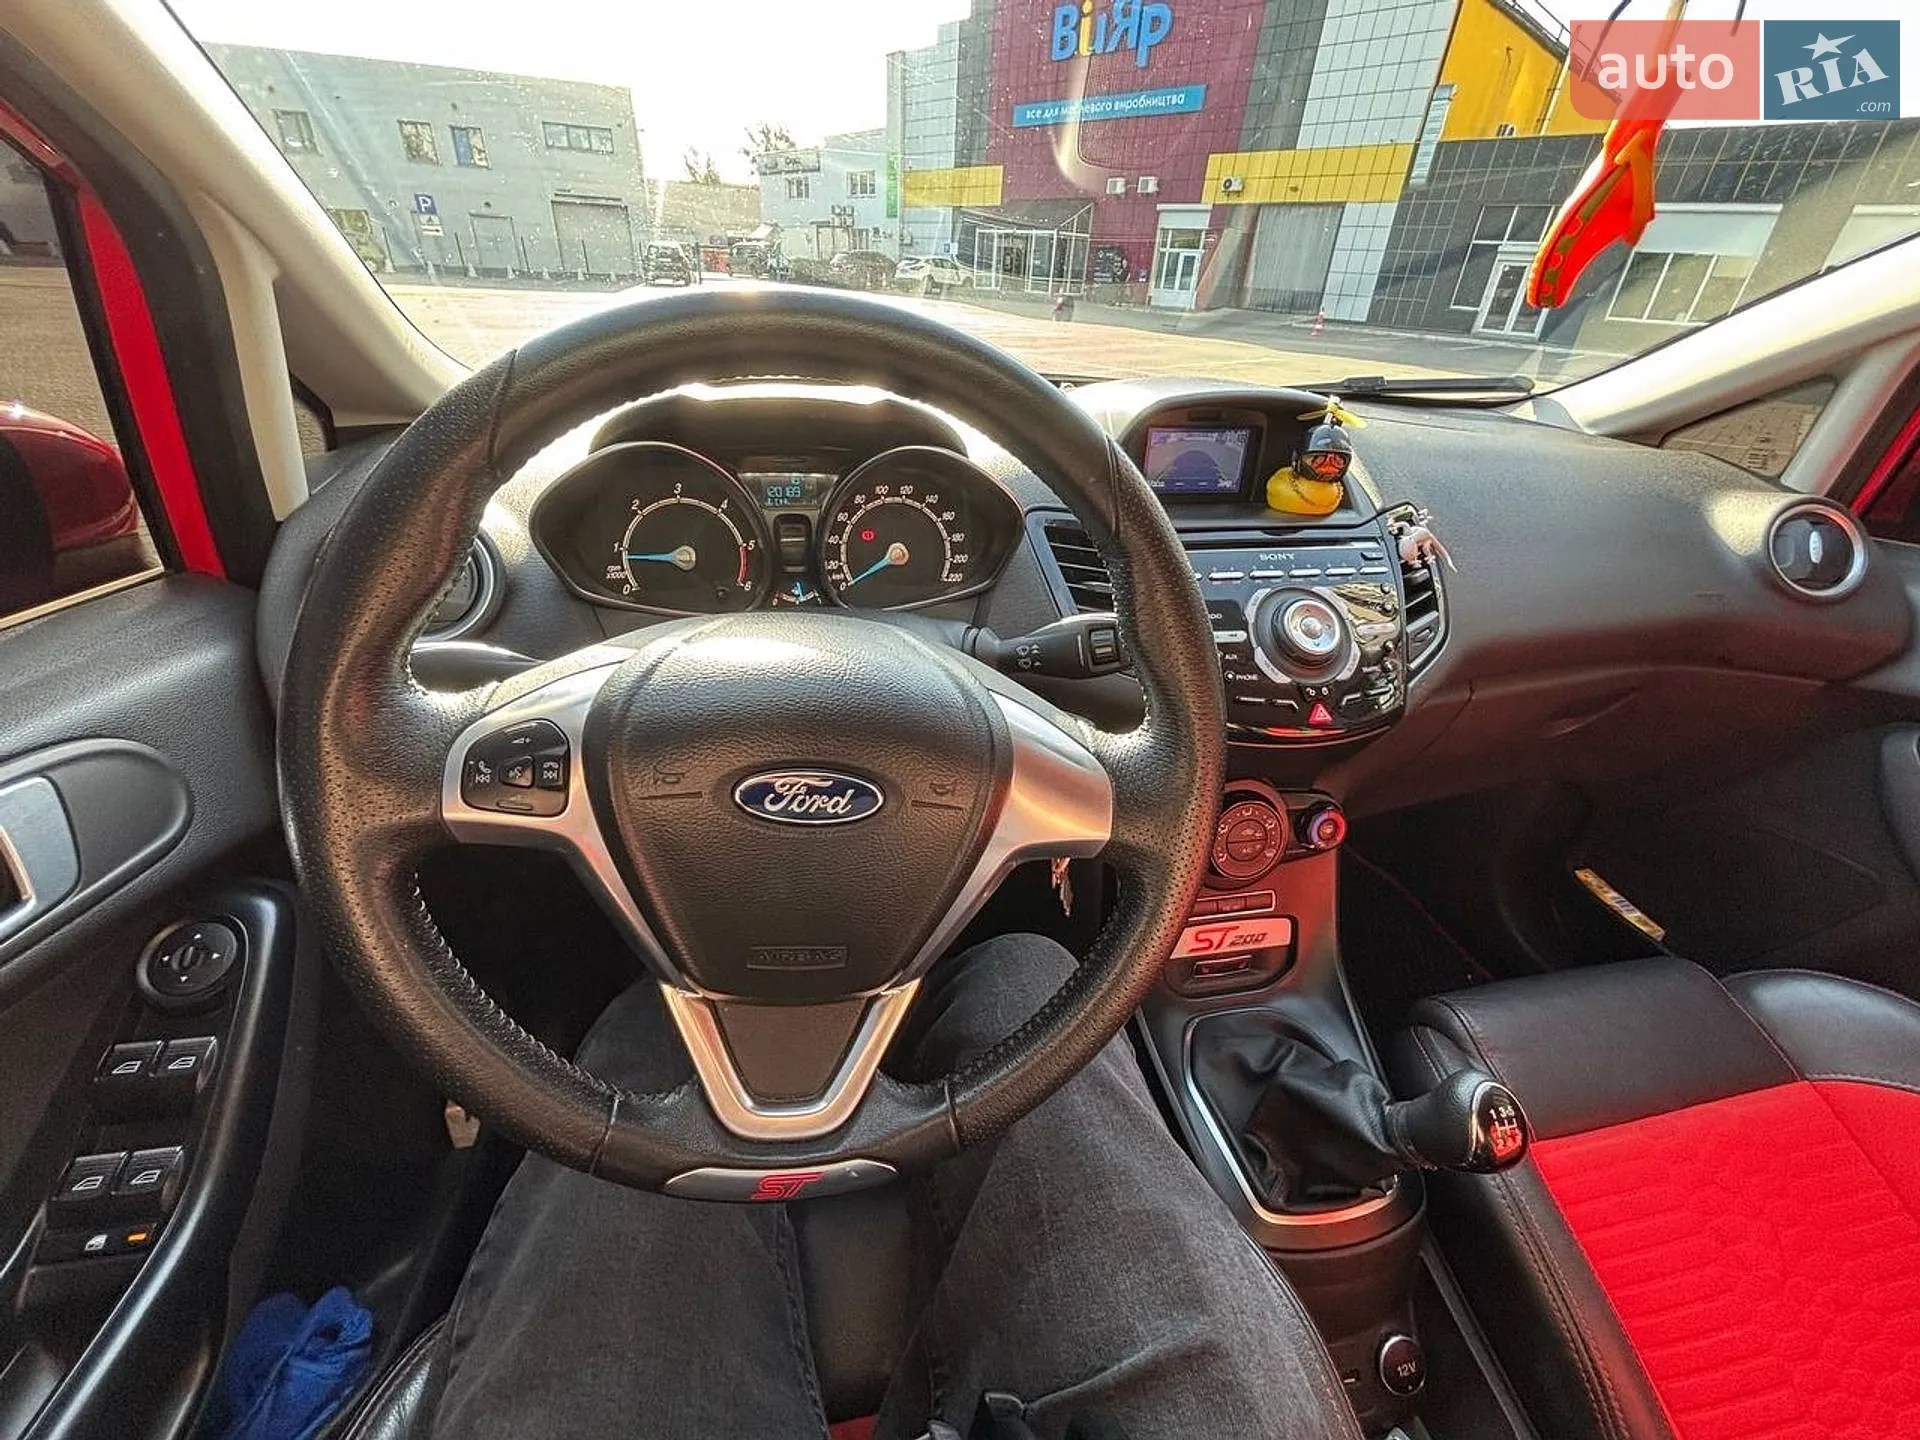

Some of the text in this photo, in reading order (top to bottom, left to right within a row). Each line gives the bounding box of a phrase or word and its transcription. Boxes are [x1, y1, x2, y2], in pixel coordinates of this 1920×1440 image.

[673, 482, 682, 495] 3
[632, 499, 640, 510] 2
[721, 498, 729, 510] 4
[748, 540, 756, 551] 5
[1259, 553, 1295, 561] SONY
[622, 584, 631, 595] 0
[744, 580, 752, 591] 6
[764, 777, 855, 815] Ford
[1188, 926, 1269, 953] ST 200
[750, 1171, 825, 1200] ST
[1397, 1361, 1416, 1377] 12V
